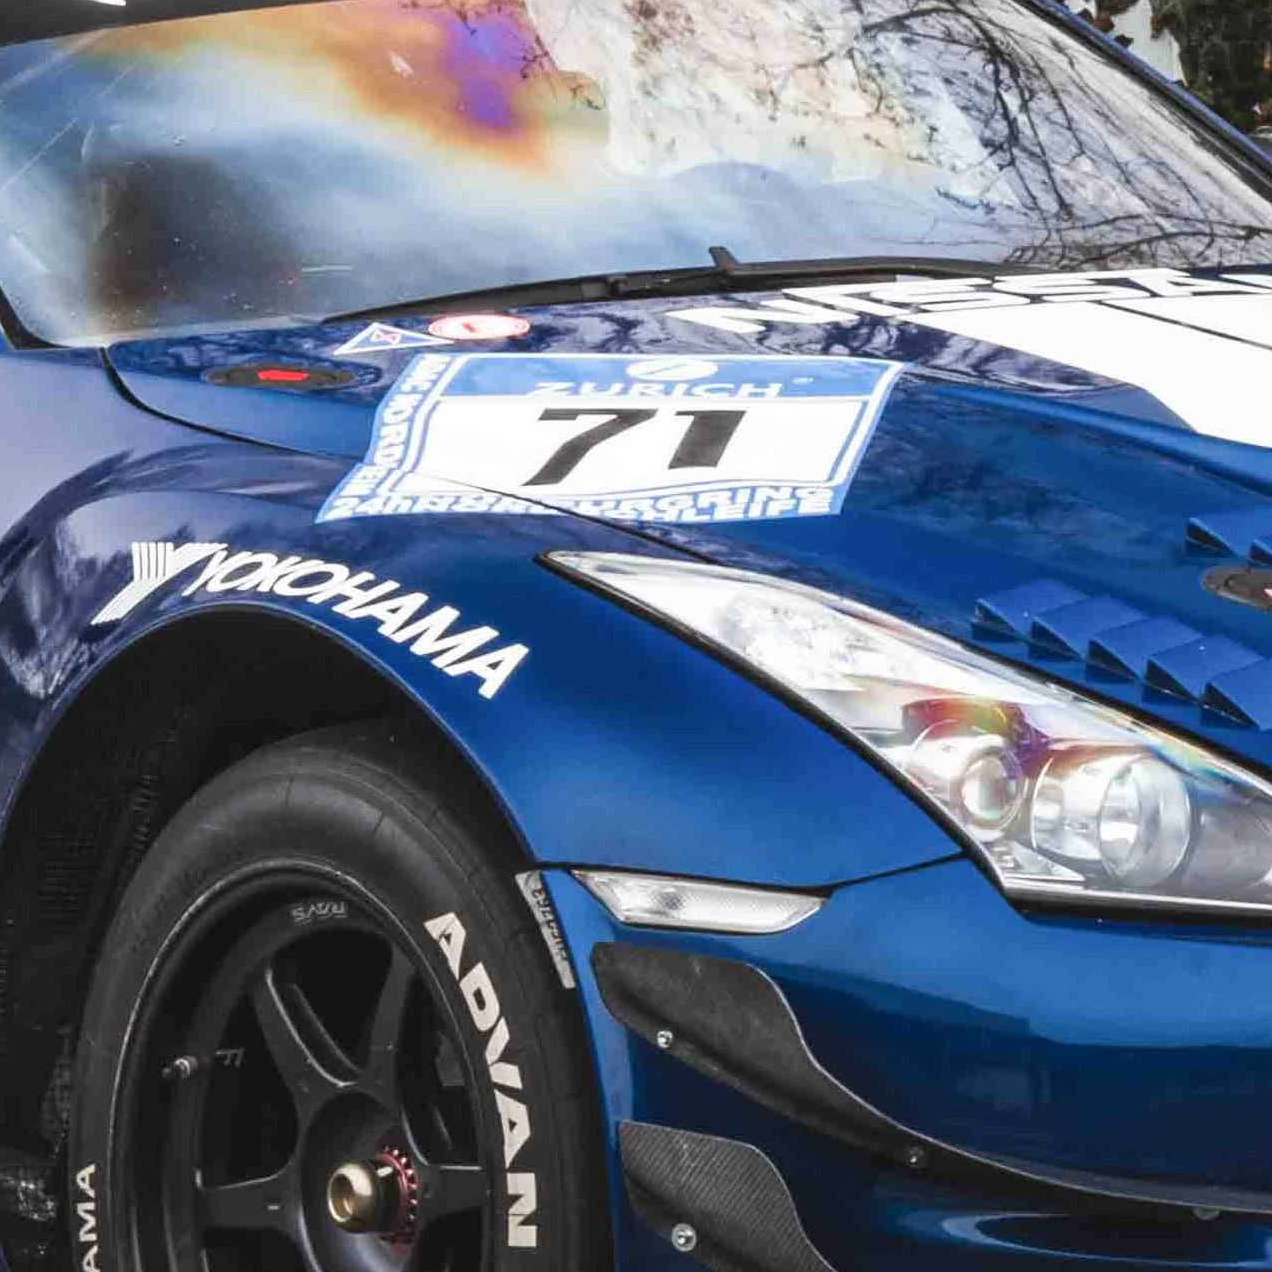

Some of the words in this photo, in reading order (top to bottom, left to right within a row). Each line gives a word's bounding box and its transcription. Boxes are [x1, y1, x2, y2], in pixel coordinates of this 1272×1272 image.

[520, 408, 747, 487] 71
[527, 382, 783, 398] ZURICH
[181, 544, 530, 700] YOKOHAMA
[424, 911, 537, 1249] ADVAN
